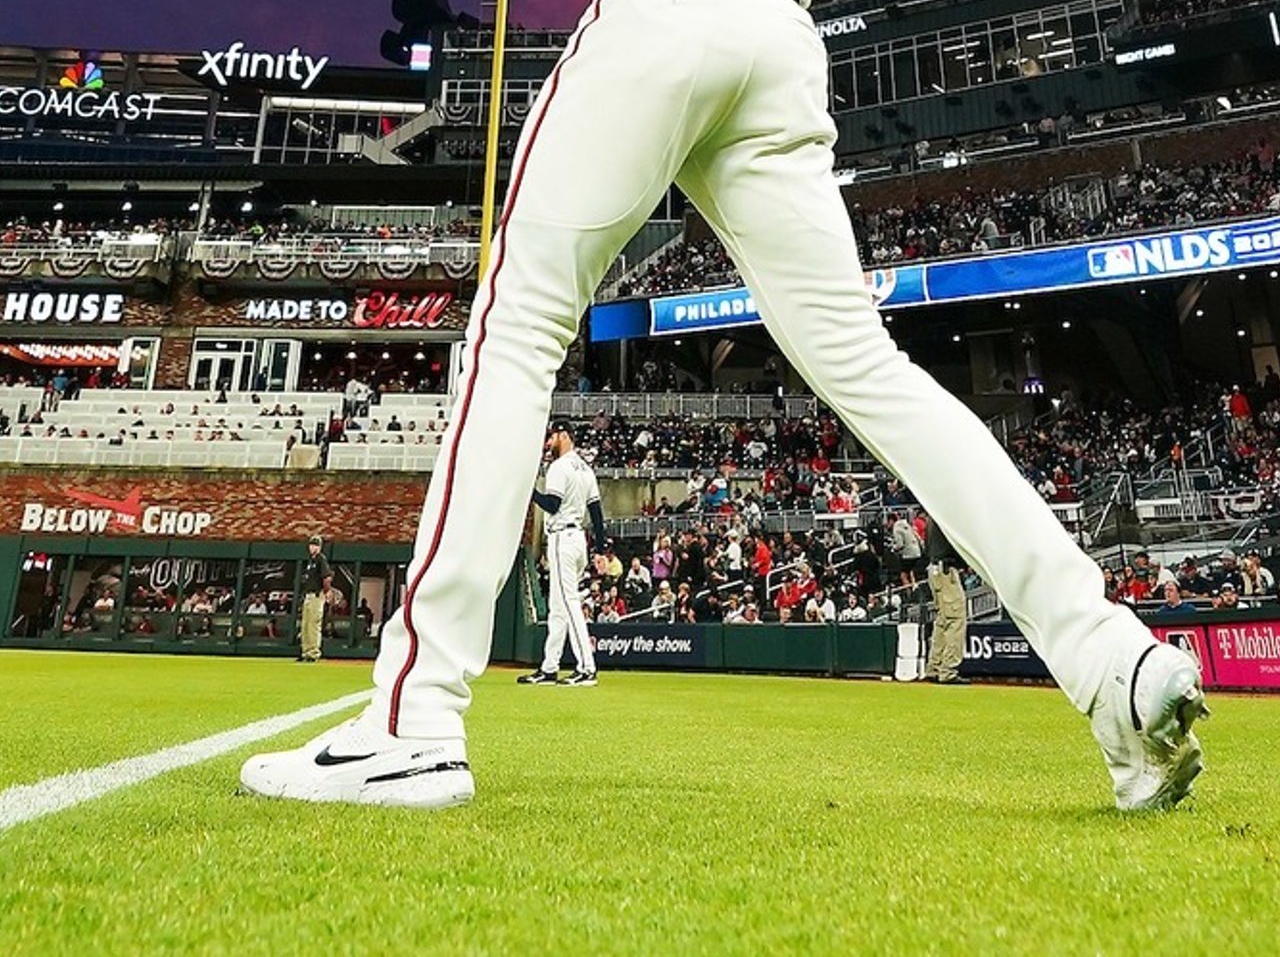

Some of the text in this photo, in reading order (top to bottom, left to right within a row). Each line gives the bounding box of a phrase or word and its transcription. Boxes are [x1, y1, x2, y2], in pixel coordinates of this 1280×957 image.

[198, 42, 330, 90] xfinity
[1134, 230, 1231, 274] NLDS
[2, 293, 124, 323] HOUSE
[245, 290, 454, 328] MADE TO Chill
[675, 298, 756, 322] PHILADE
[21, 503, 212, 535] BELOW THE CHOP
[597, 635, 692, 655] enjoy the show.
[994, 641, 1029, 653] 2022
